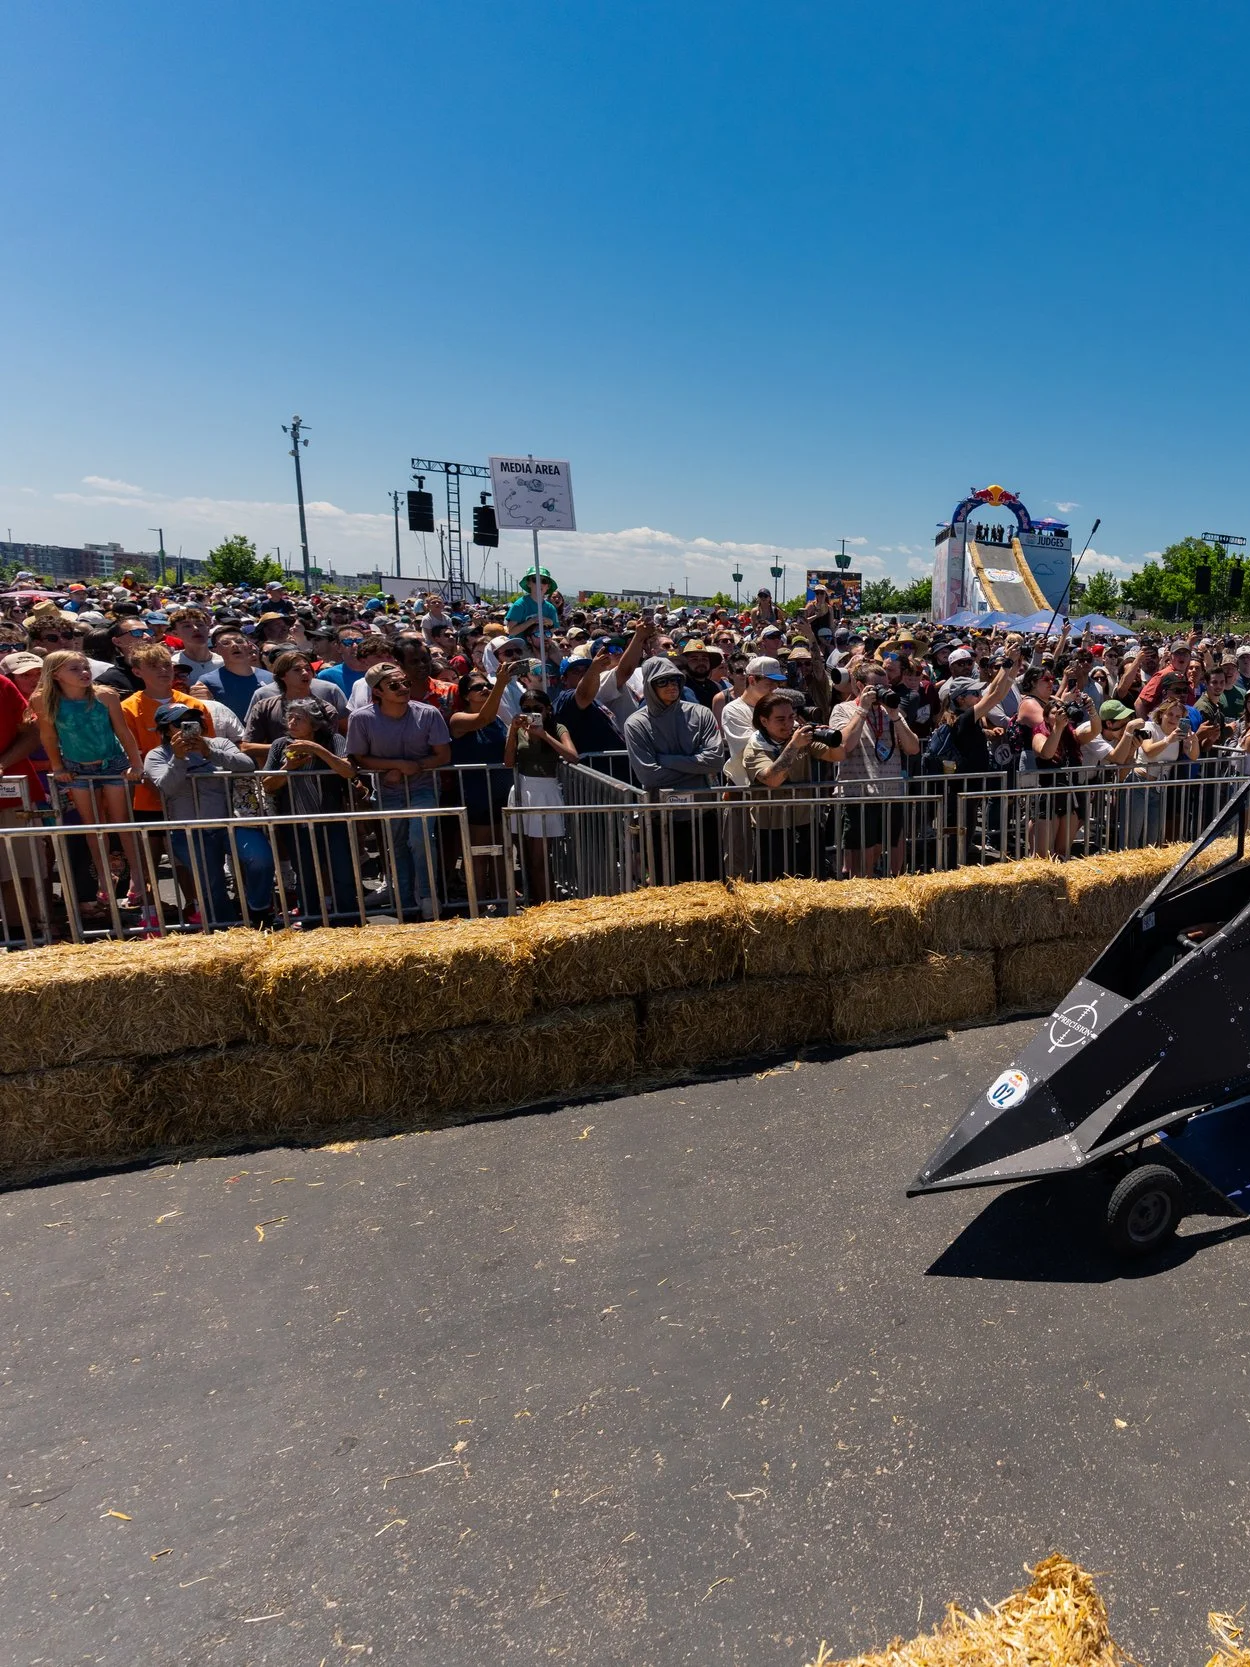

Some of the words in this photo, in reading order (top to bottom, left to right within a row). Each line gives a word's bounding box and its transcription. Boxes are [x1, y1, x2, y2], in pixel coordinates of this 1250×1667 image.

[500, 461, 532, 474] MEDIA
[535, 464, 561, 476] AREA
[1037, 538, 1064, 548] JUDGES
[1057, 1013, 1093, 1037] PRECISION
[992, 1082, 1016, 1106] 02
